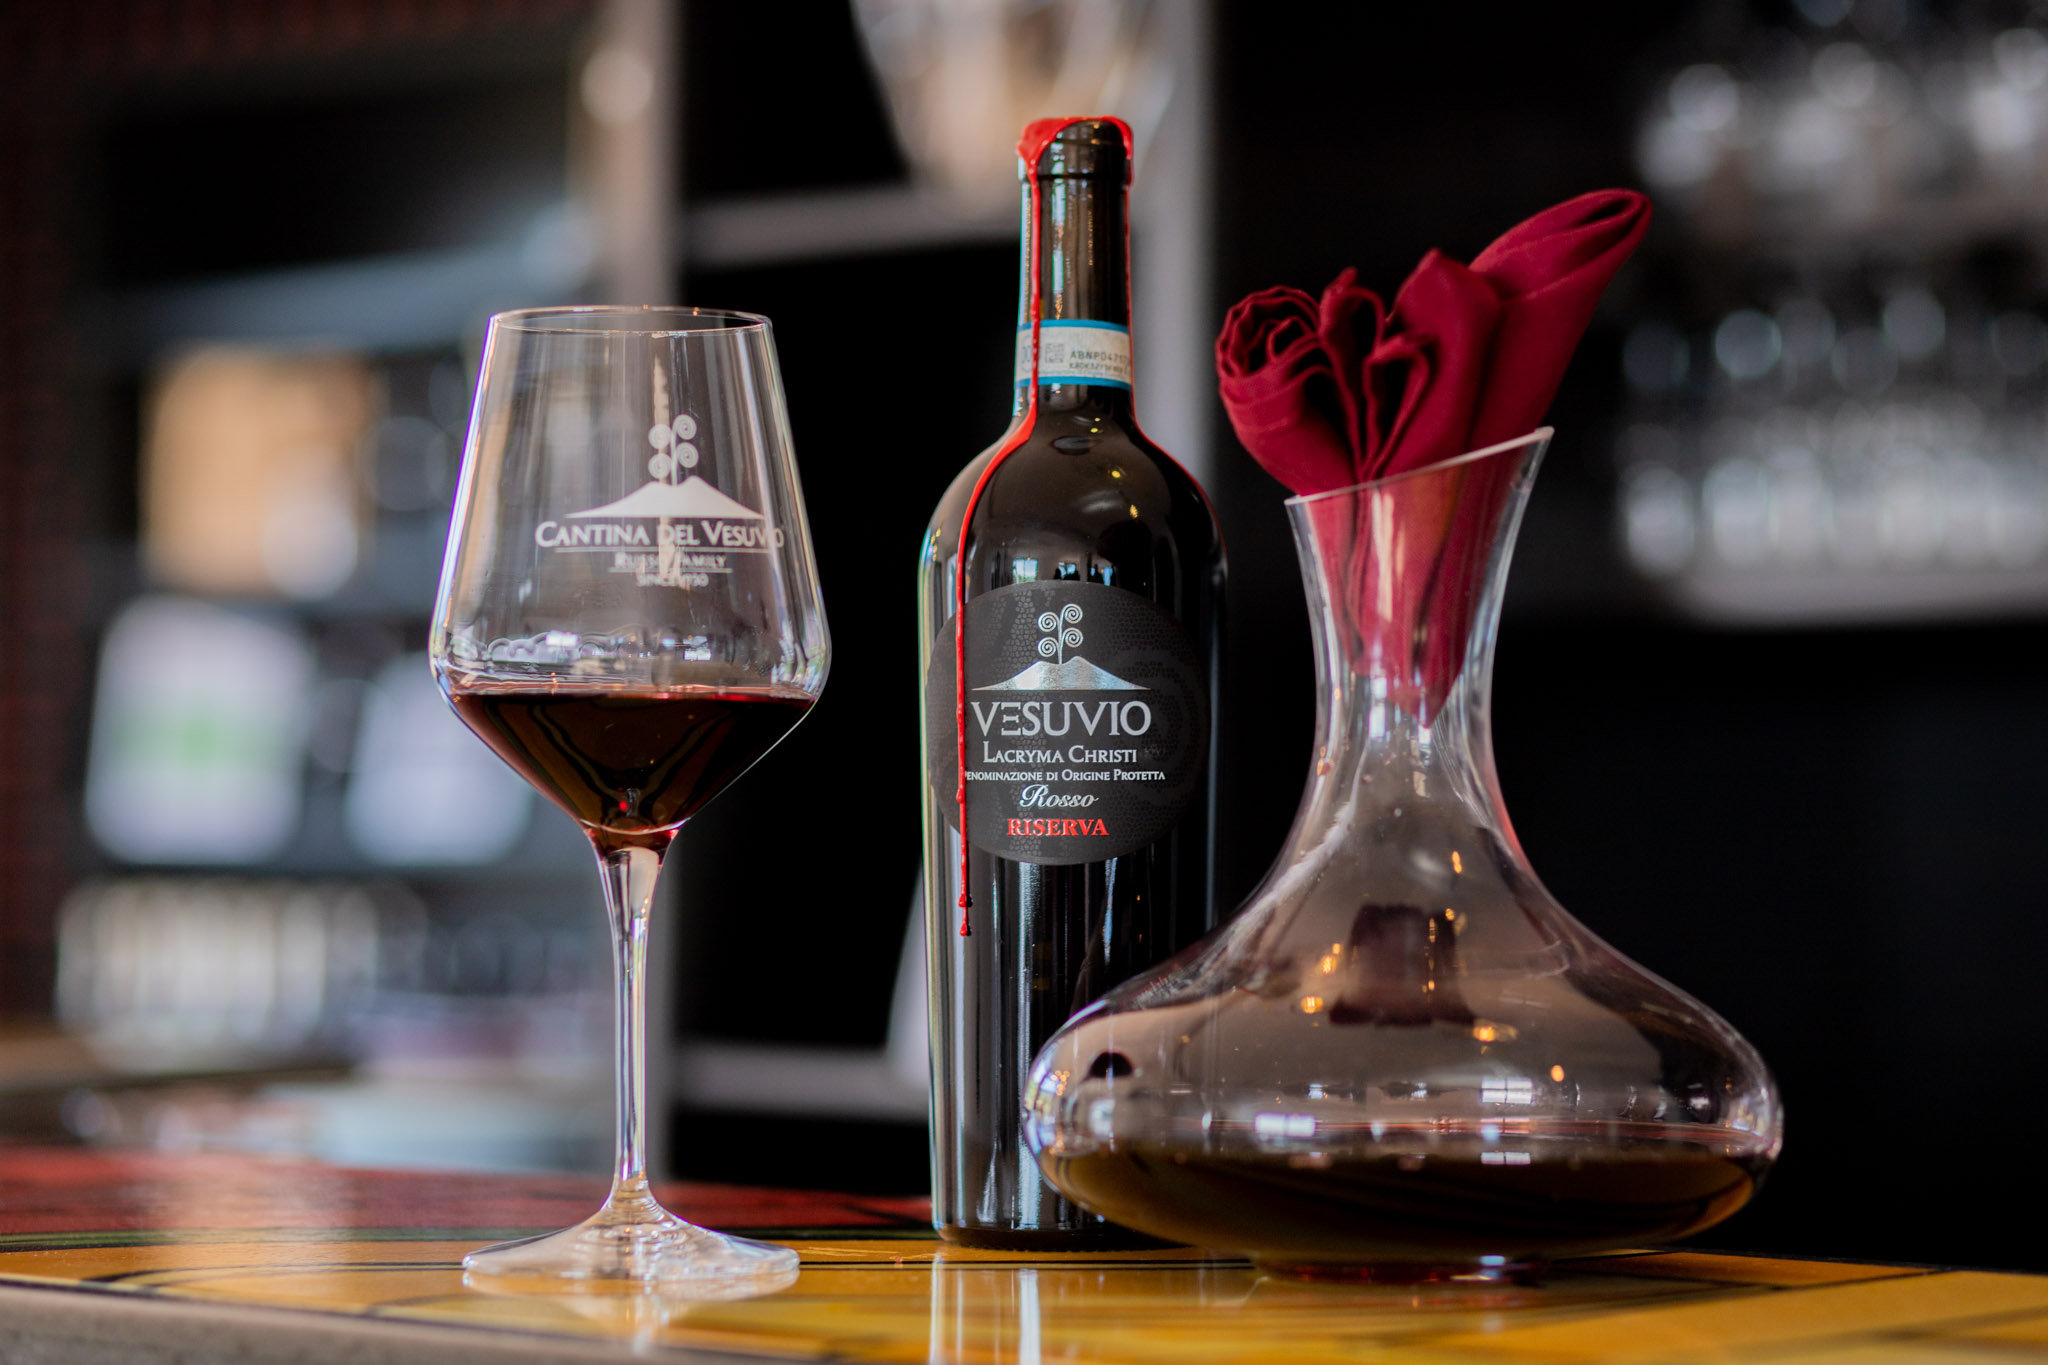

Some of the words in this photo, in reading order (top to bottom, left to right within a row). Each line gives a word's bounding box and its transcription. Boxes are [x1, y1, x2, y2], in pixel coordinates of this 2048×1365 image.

[535, 521, 650, 547] CANTINA
[657, 524, 700, 546] DEL
[701, 519, 784, 548] VESUVO
[615, 552, 673, 568] RUSS
[970, 701, 1152, 736] VESUVIO
[983, 740, 1065, 763] LACRYMA
[1068, 745, 1137, 763] CHRISTI
[965, 770, 1042, 781] ENOMINAZIONE
[1046, 770, 1058, 781] DI
[1061, 769, 1110, 782] ORIGINE
[1113, 768, 1165, 781] PROTETTA
[1018, 783, 1099, 808] Rosso
[1007, 817, 1110, 837] RISERVA
